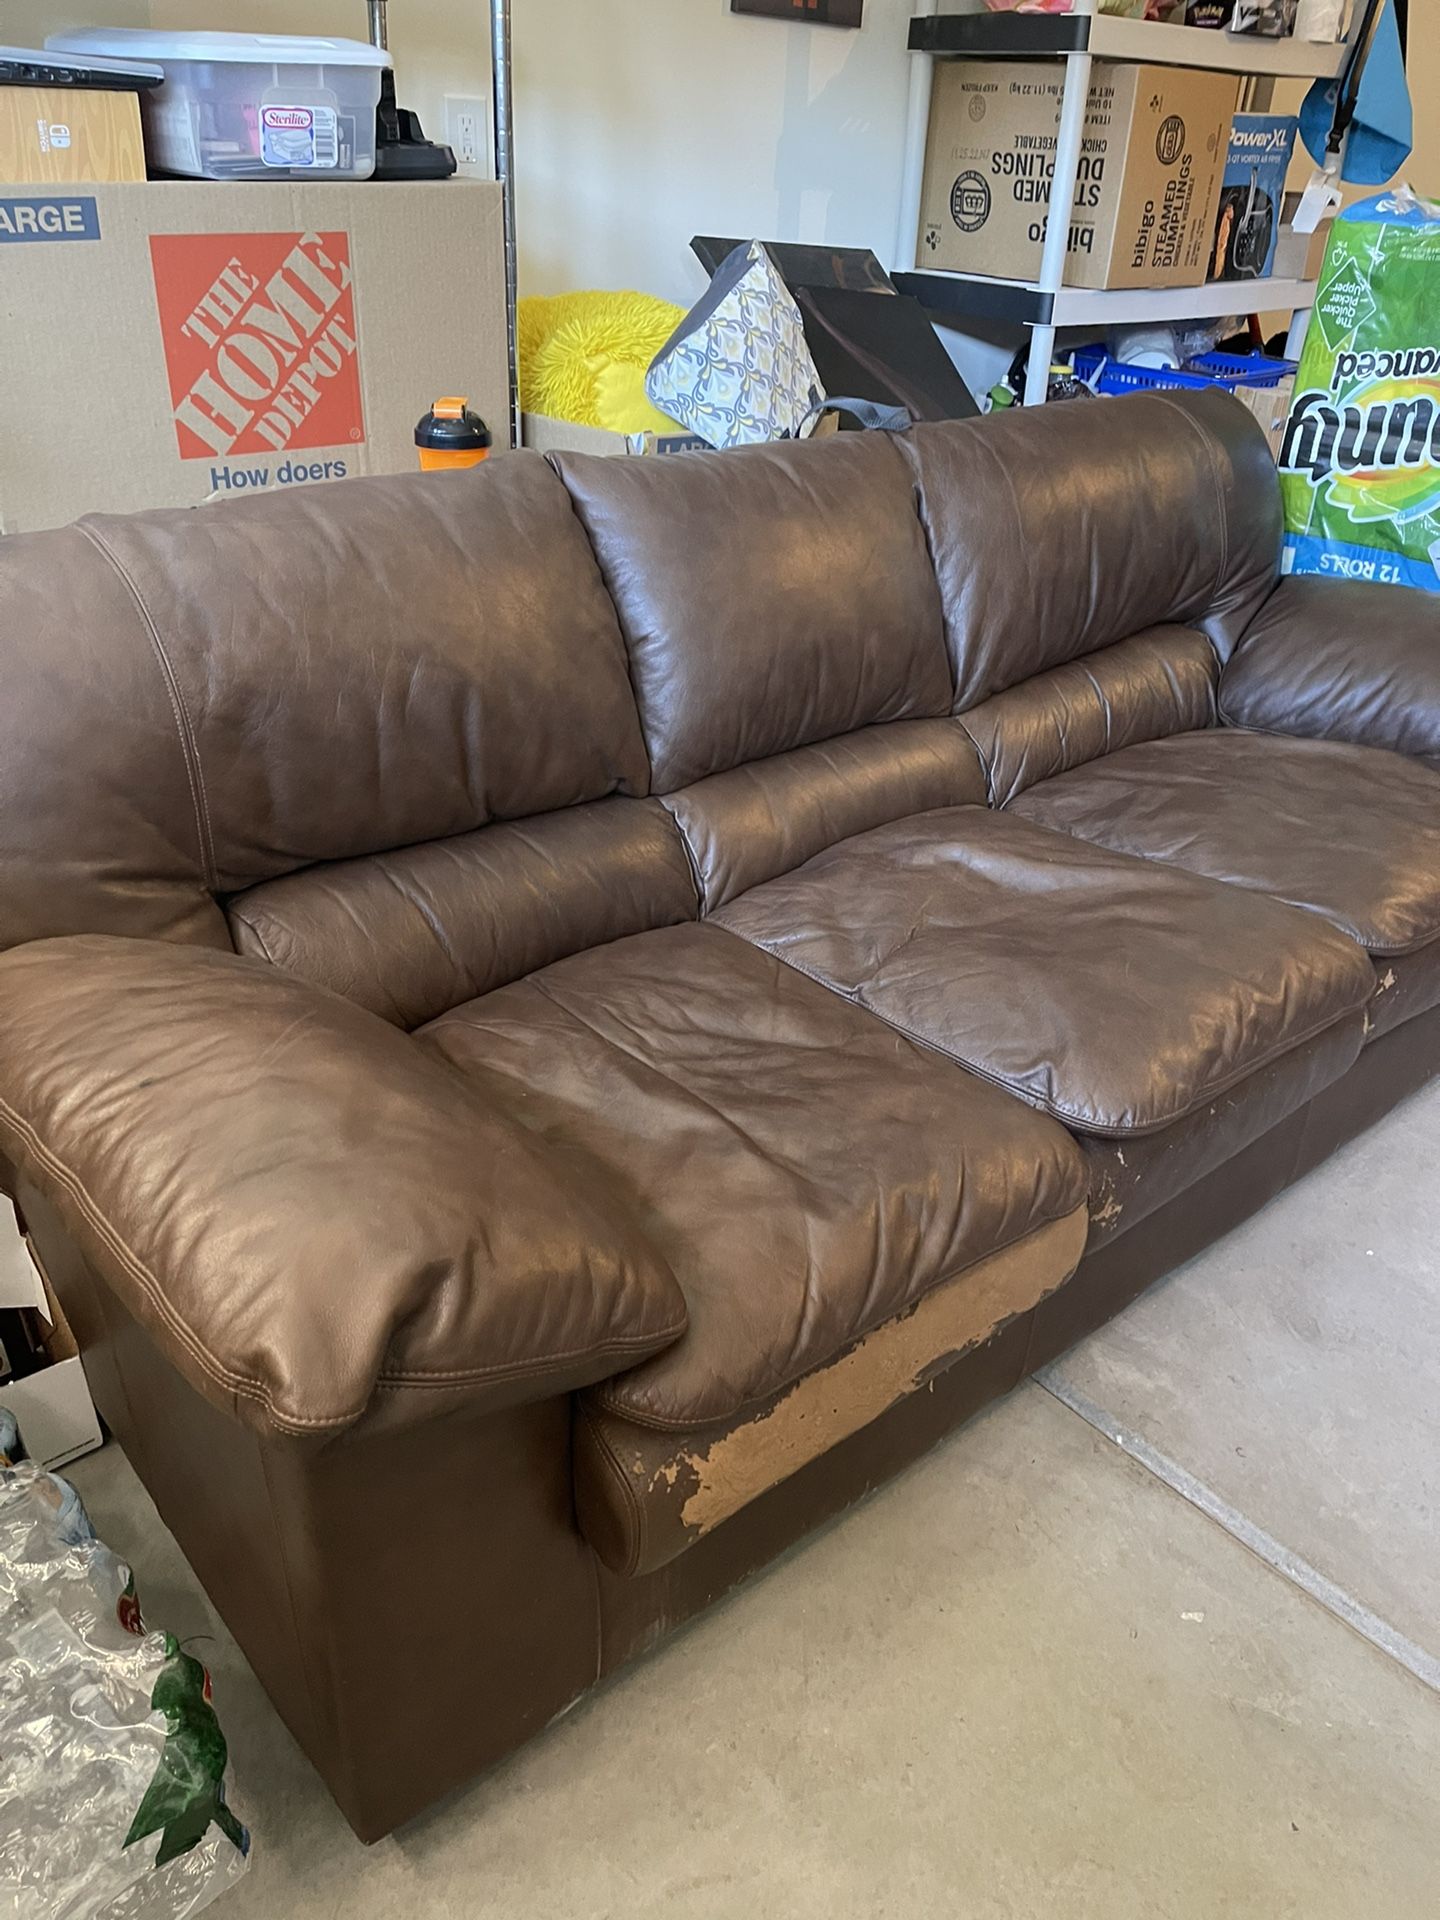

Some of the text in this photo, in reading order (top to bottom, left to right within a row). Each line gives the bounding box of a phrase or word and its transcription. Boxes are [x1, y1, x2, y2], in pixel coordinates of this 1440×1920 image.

[1091, 115, 1111, 125] ITEM
[992, 152, 1105, 181] DUPLINGS
[1152, 180, 1177, 267] STEAMED
[1162, 154, 1193, 267] DUMPLINGS
[1131, 200, 1155, 268] bibigo
[181, 257, 260, 349] THE
[1329, 293, 1359, 307] Picker
[1332, 281, 1362, 296] Upper
[1321, 304, 1356, 318] Quicker
[1335, 317, 1352, 329] The
[174, 231, 351, 456] HOME
[253, 313, 356, 451] DEPOT
[210, 460, 347, 491] How doers
[1320, 553, 1400, 584] 12 ROLLS
